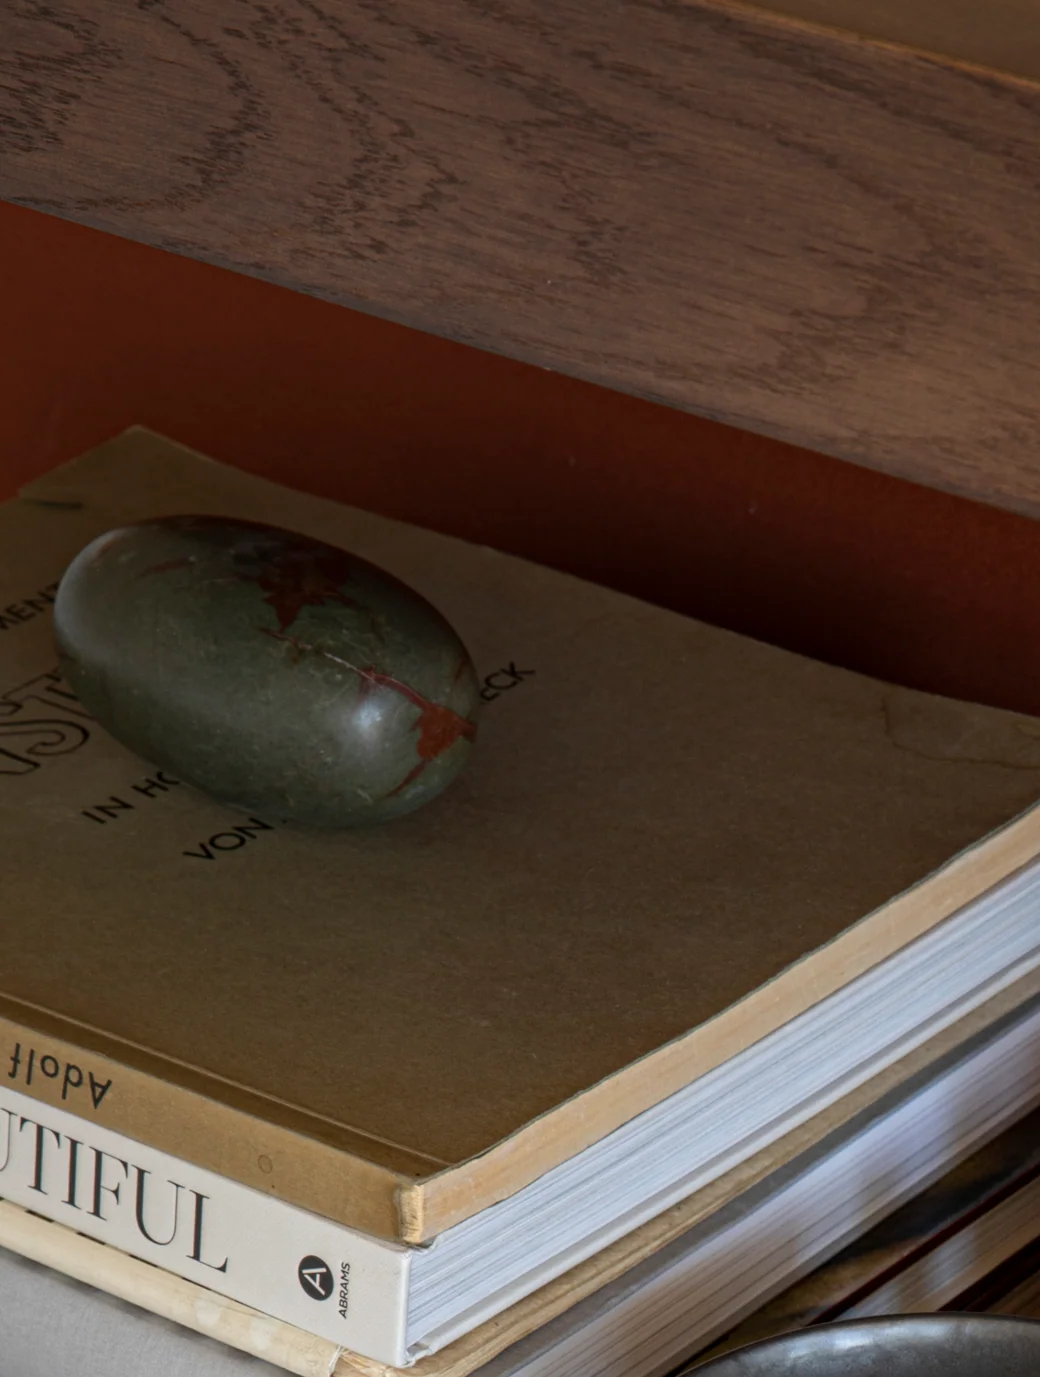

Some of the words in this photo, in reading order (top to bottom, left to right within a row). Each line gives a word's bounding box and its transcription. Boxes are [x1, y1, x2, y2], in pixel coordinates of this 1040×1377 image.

[0, 667, 98, 776] ST
[81, 795, 135, 825] IN
[182, 817, 275, 860] VON
[8, 1043, 112, 1109] Adolf
[338, 1261, 351, 1319] ABRAMS
